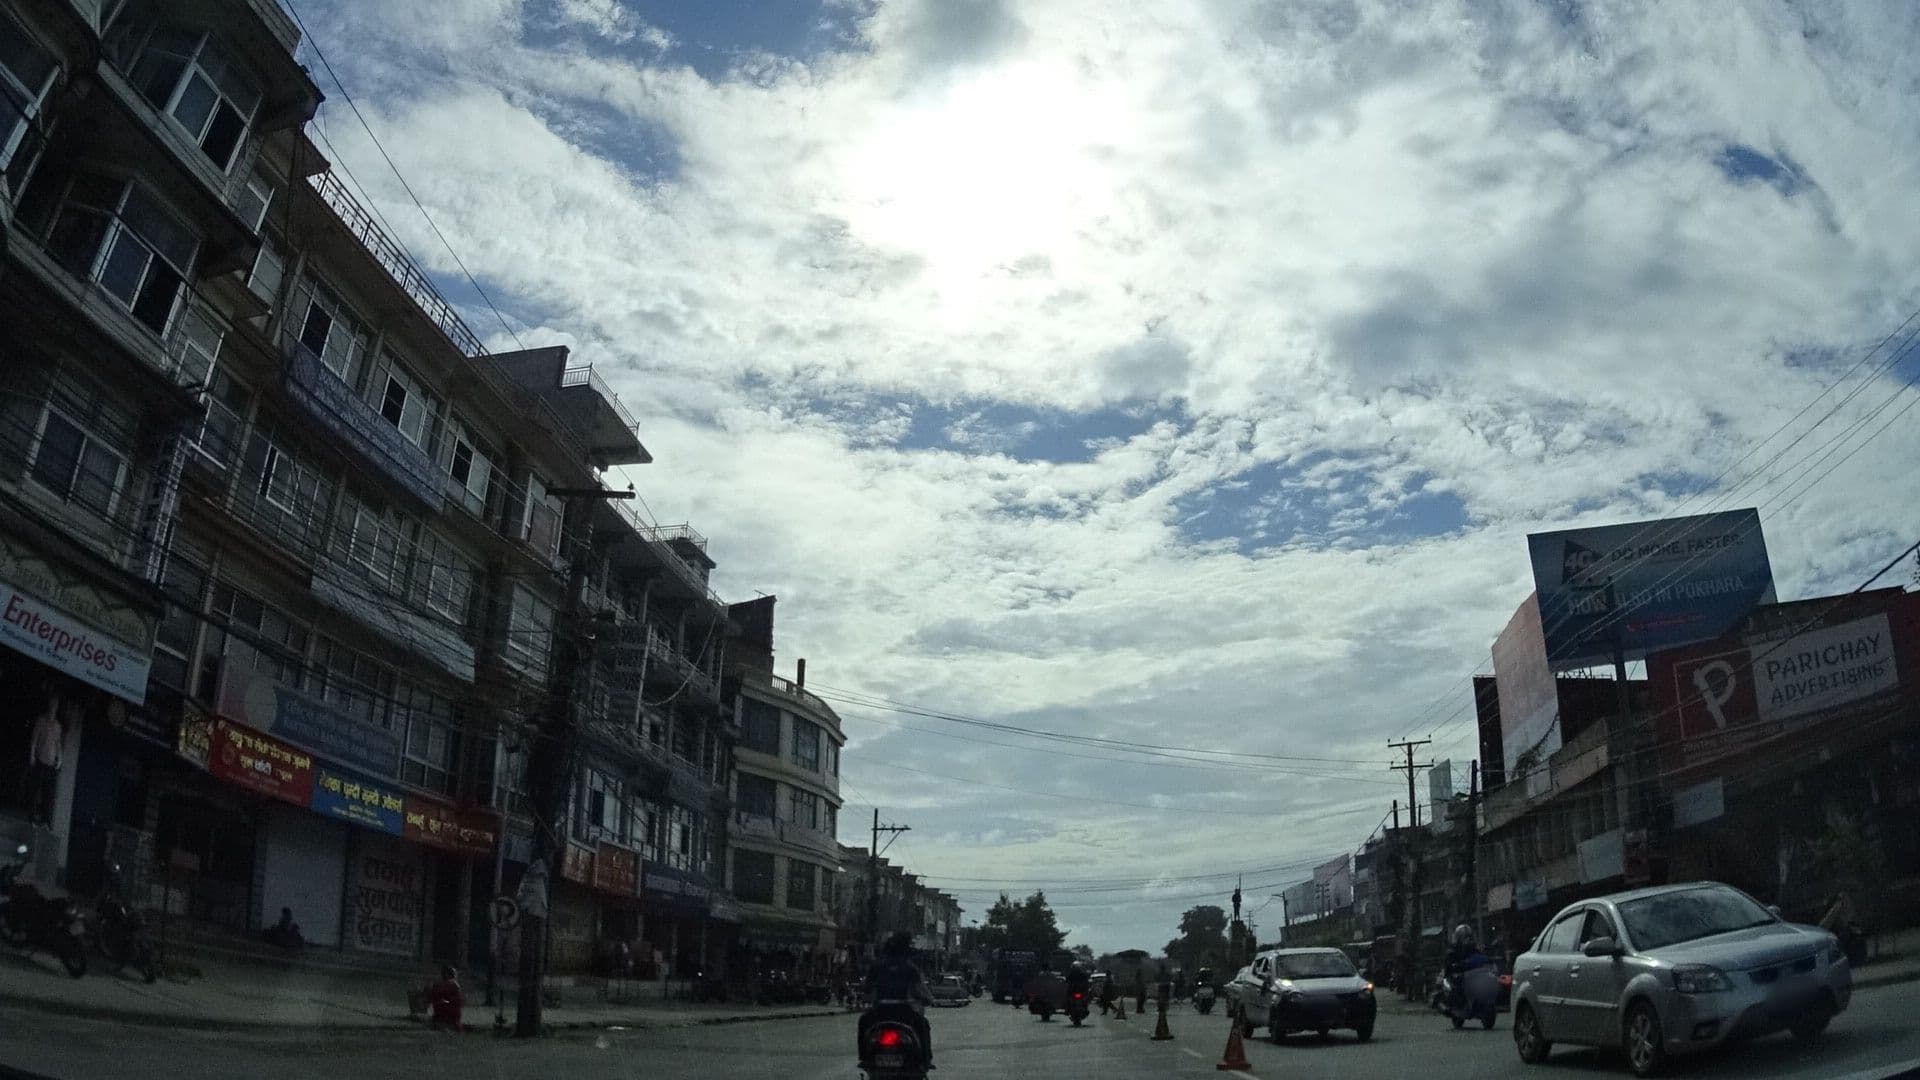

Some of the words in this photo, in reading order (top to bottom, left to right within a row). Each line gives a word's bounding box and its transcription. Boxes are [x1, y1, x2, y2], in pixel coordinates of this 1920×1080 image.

[1674, 577, 1746, 601] POKHARA
[3, 593, 118, 672] Enterprises
[1766, 632, 1881, 682] PARICHAY
[1771, 661, 1885, 705] ADVERTISING
